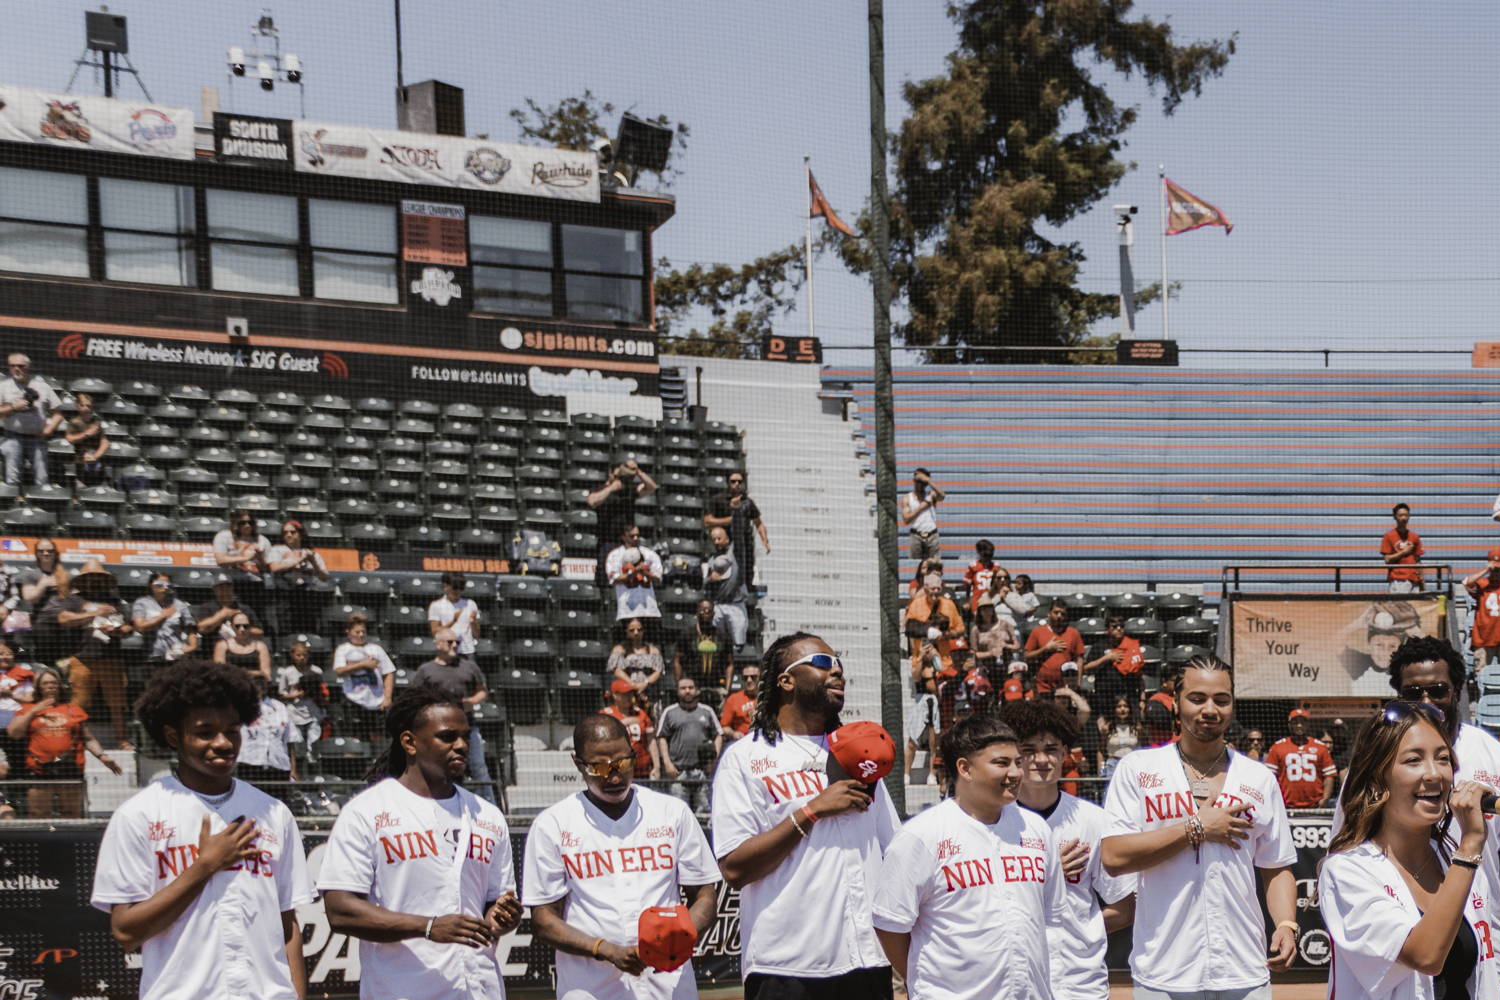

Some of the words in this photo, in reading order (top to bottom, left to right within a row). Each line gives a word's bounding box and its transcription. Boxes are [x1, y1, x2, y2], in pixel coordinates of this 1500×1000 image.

[229, 119, 279, 141] SOUTH
[222, 138, 288, 161] DIVISION
[531, 161, 593, 185] Rawhide
[86, 338, 122, 358] FREE
[124, 341, 184, 363] Wireless
[279, 352, 320, 373] Guest
[524, 331, 655, 357] sjgiants.com
[1246, 617, 1293, 633] Thrive
[1265, 640, 1300, 655] Your
[1288, 663, 1320, 682] Way
[553, 774, 578, 782] ROW
[1285, 752, 1319, 783] 85
[561, 843, 674, 880] NINERS
[941, 855, 1046, 893] NINERS
